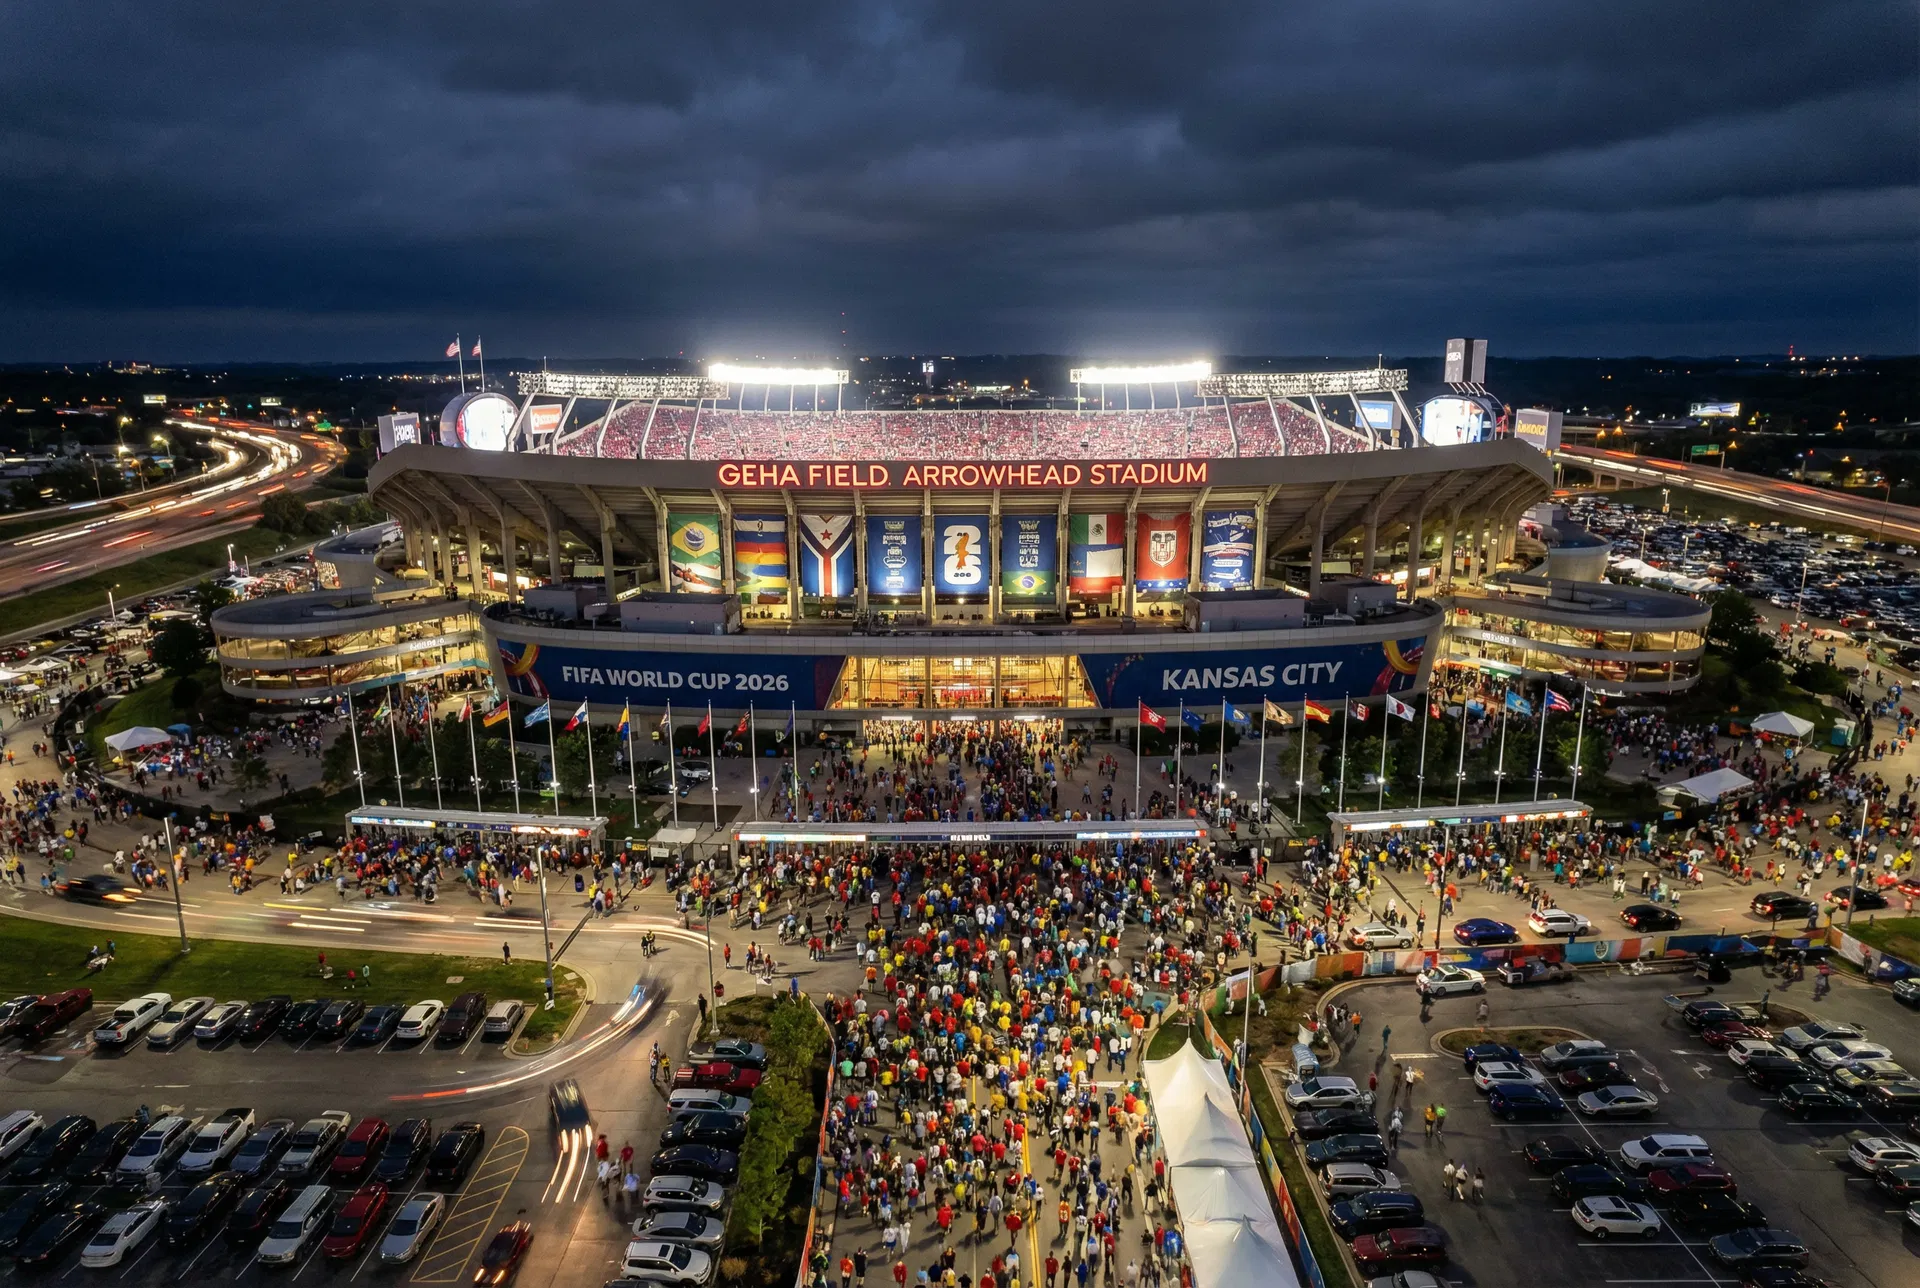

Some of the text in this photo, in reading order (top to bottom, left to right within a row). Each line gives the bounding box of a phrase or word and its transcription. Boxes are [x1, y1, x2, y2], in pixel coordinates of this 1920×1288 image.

[718, 463, 800, 486] GEHA
[902, 464, 1081, 486] ARROWHEAD
[1089, 462, 1208, 485] STADIUM
[562, 666, 789, 692] FIFA WORLD CUP 2026
[1162, 661, 1344, 690] KANSAS CITY
